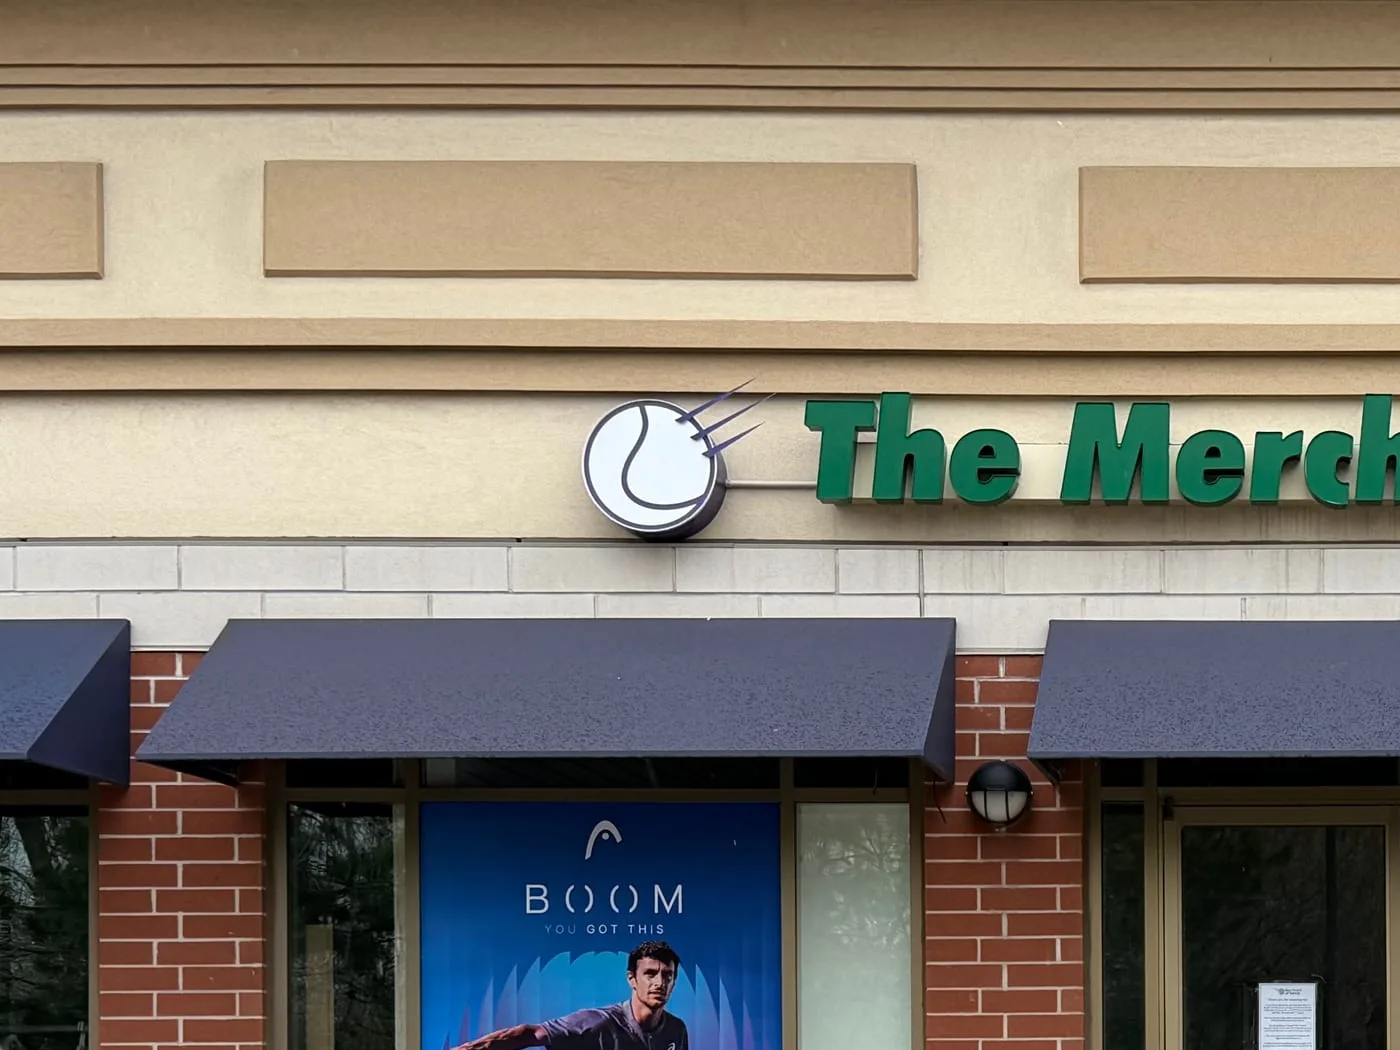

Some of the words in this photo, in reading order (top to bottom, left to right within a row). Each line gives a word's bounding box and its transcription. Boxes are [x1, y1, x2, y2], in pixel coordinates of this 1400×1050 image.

[805, 392, 1021, 504] The
[525, 884, 684, 915] BOOM
[544, 924, 577, 935] YOU
[586, 924, 618, 935] GOT
[627, 924, 664, 935] THIS
